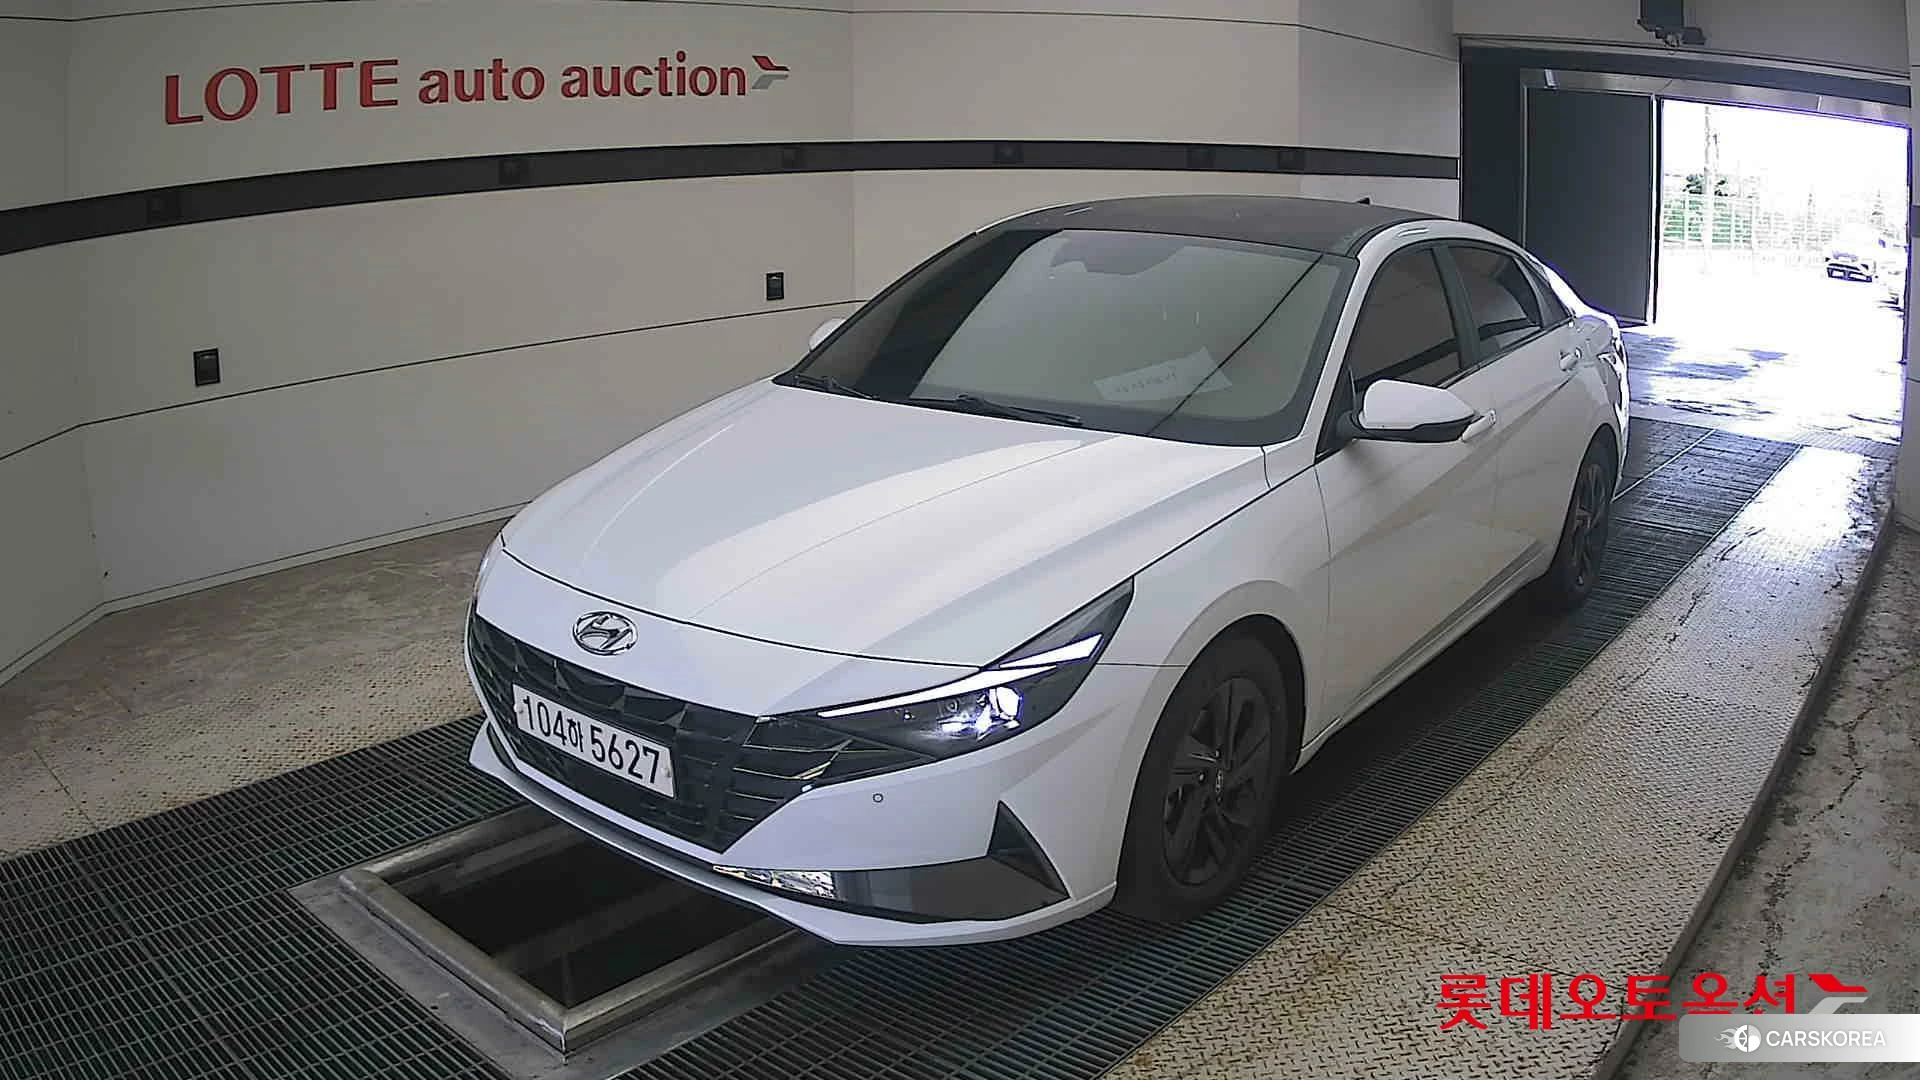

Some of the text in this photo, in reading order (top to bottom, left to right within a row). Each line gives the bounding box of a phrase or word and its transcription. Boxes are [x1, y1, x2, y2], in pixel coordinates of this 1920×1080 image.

[165, 50, 748, 125] LOTTE auto auction
[523, 695, 660, 784] 104하 5627
